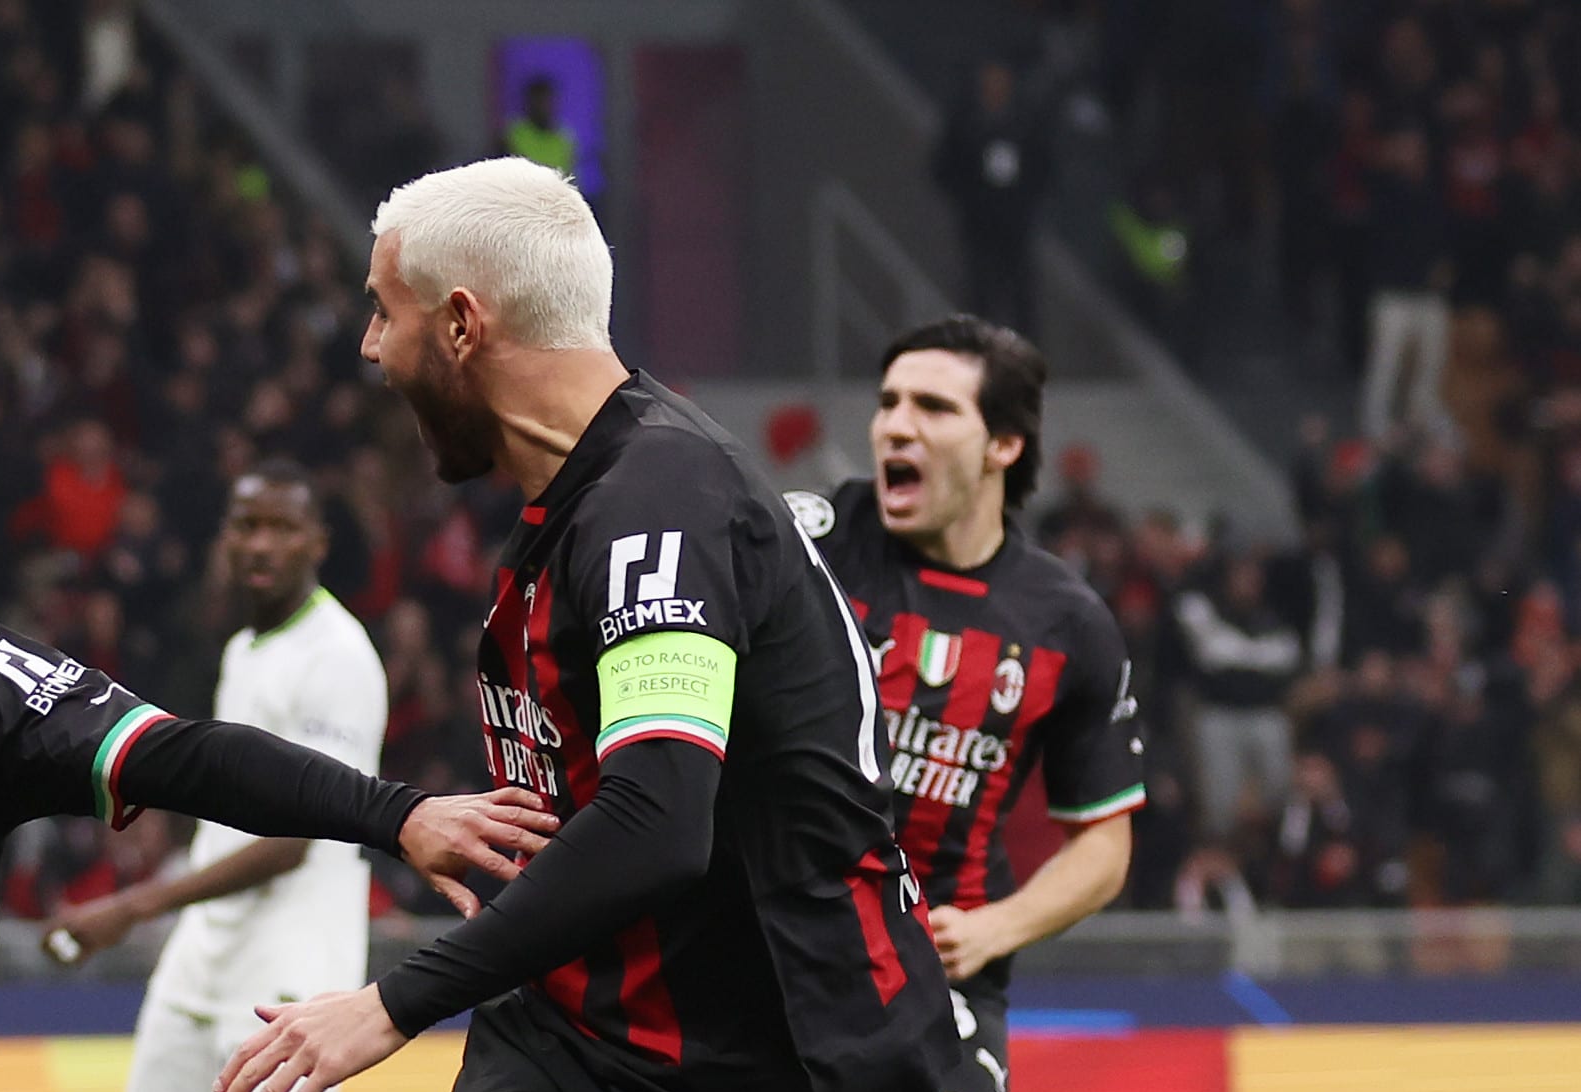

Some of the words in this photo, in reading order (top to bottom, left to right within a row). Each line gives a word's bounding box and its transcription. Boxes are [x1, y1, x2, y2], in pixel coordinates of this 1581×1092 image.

[599, 599, 708, 645] BitMEX
[25, 657, 87, 716] BitME
[610, 659, 631, 676] NO
[634, 653, 655, 667] TO
[659, 652, 719, 673] RACISM
[638, 677, 710, 695] RESPECT
[477, 672, 563, 749] irates
